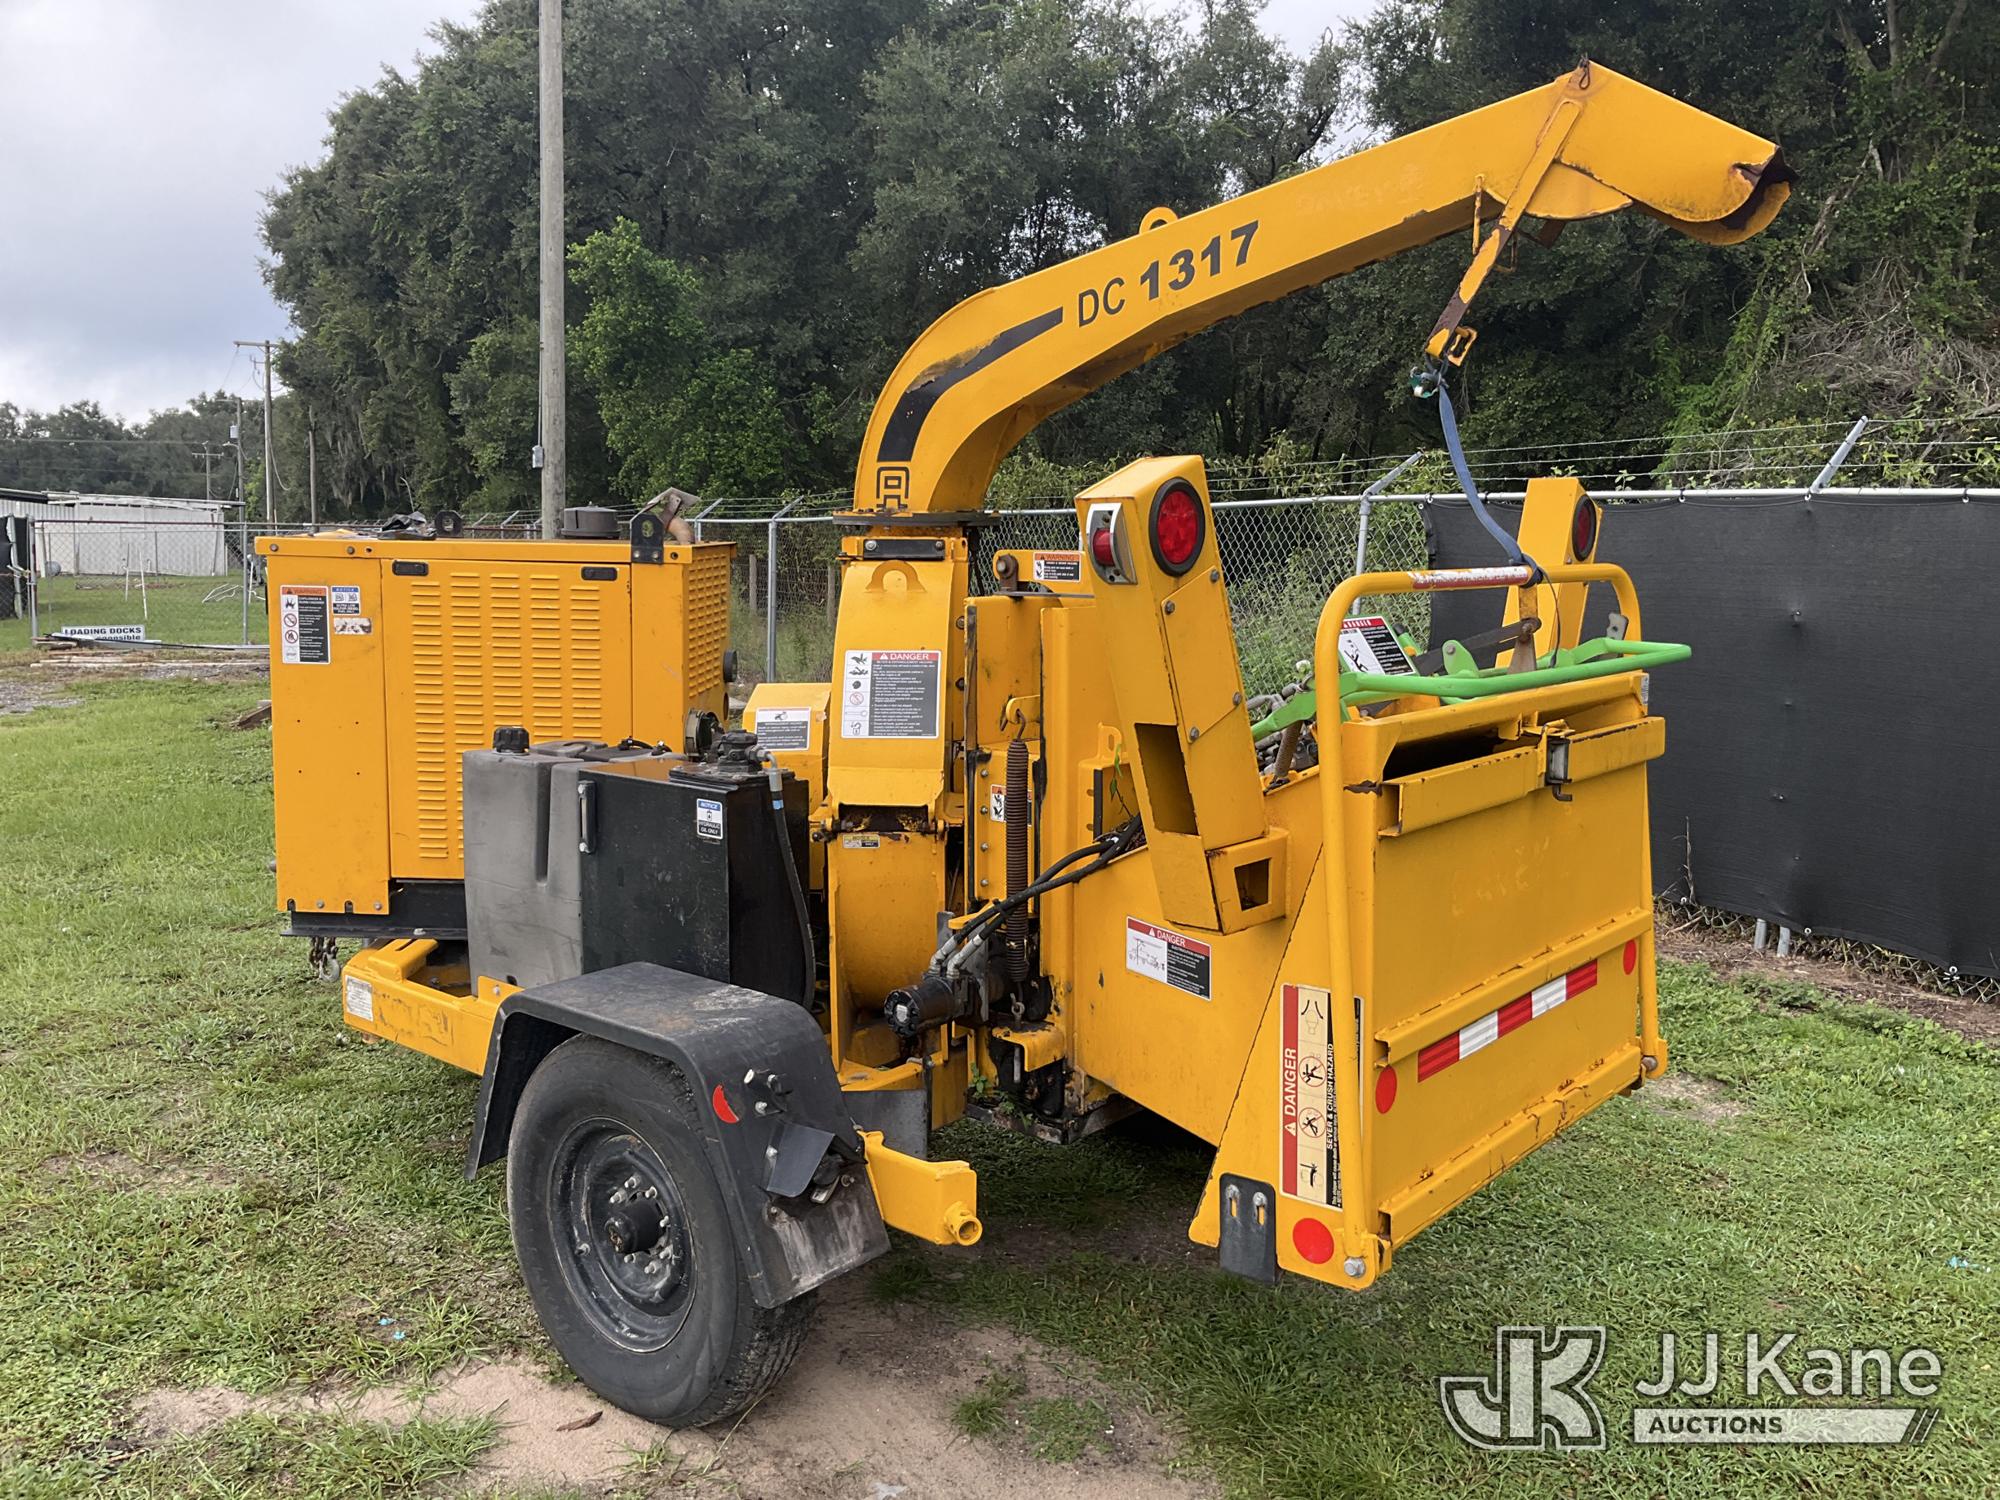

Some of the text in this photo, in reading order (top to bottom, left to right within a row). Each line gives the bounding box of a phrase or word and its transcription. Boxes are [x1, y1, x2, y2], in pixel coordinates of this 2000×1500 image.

[1079, 220, 1259, 328] DC 1317
[65, 627, 142, 636] LOADING DOCKS
[1157, 930, 1186, 947] DANGER
[1285, 1048, 1297, 1116] DANGER
